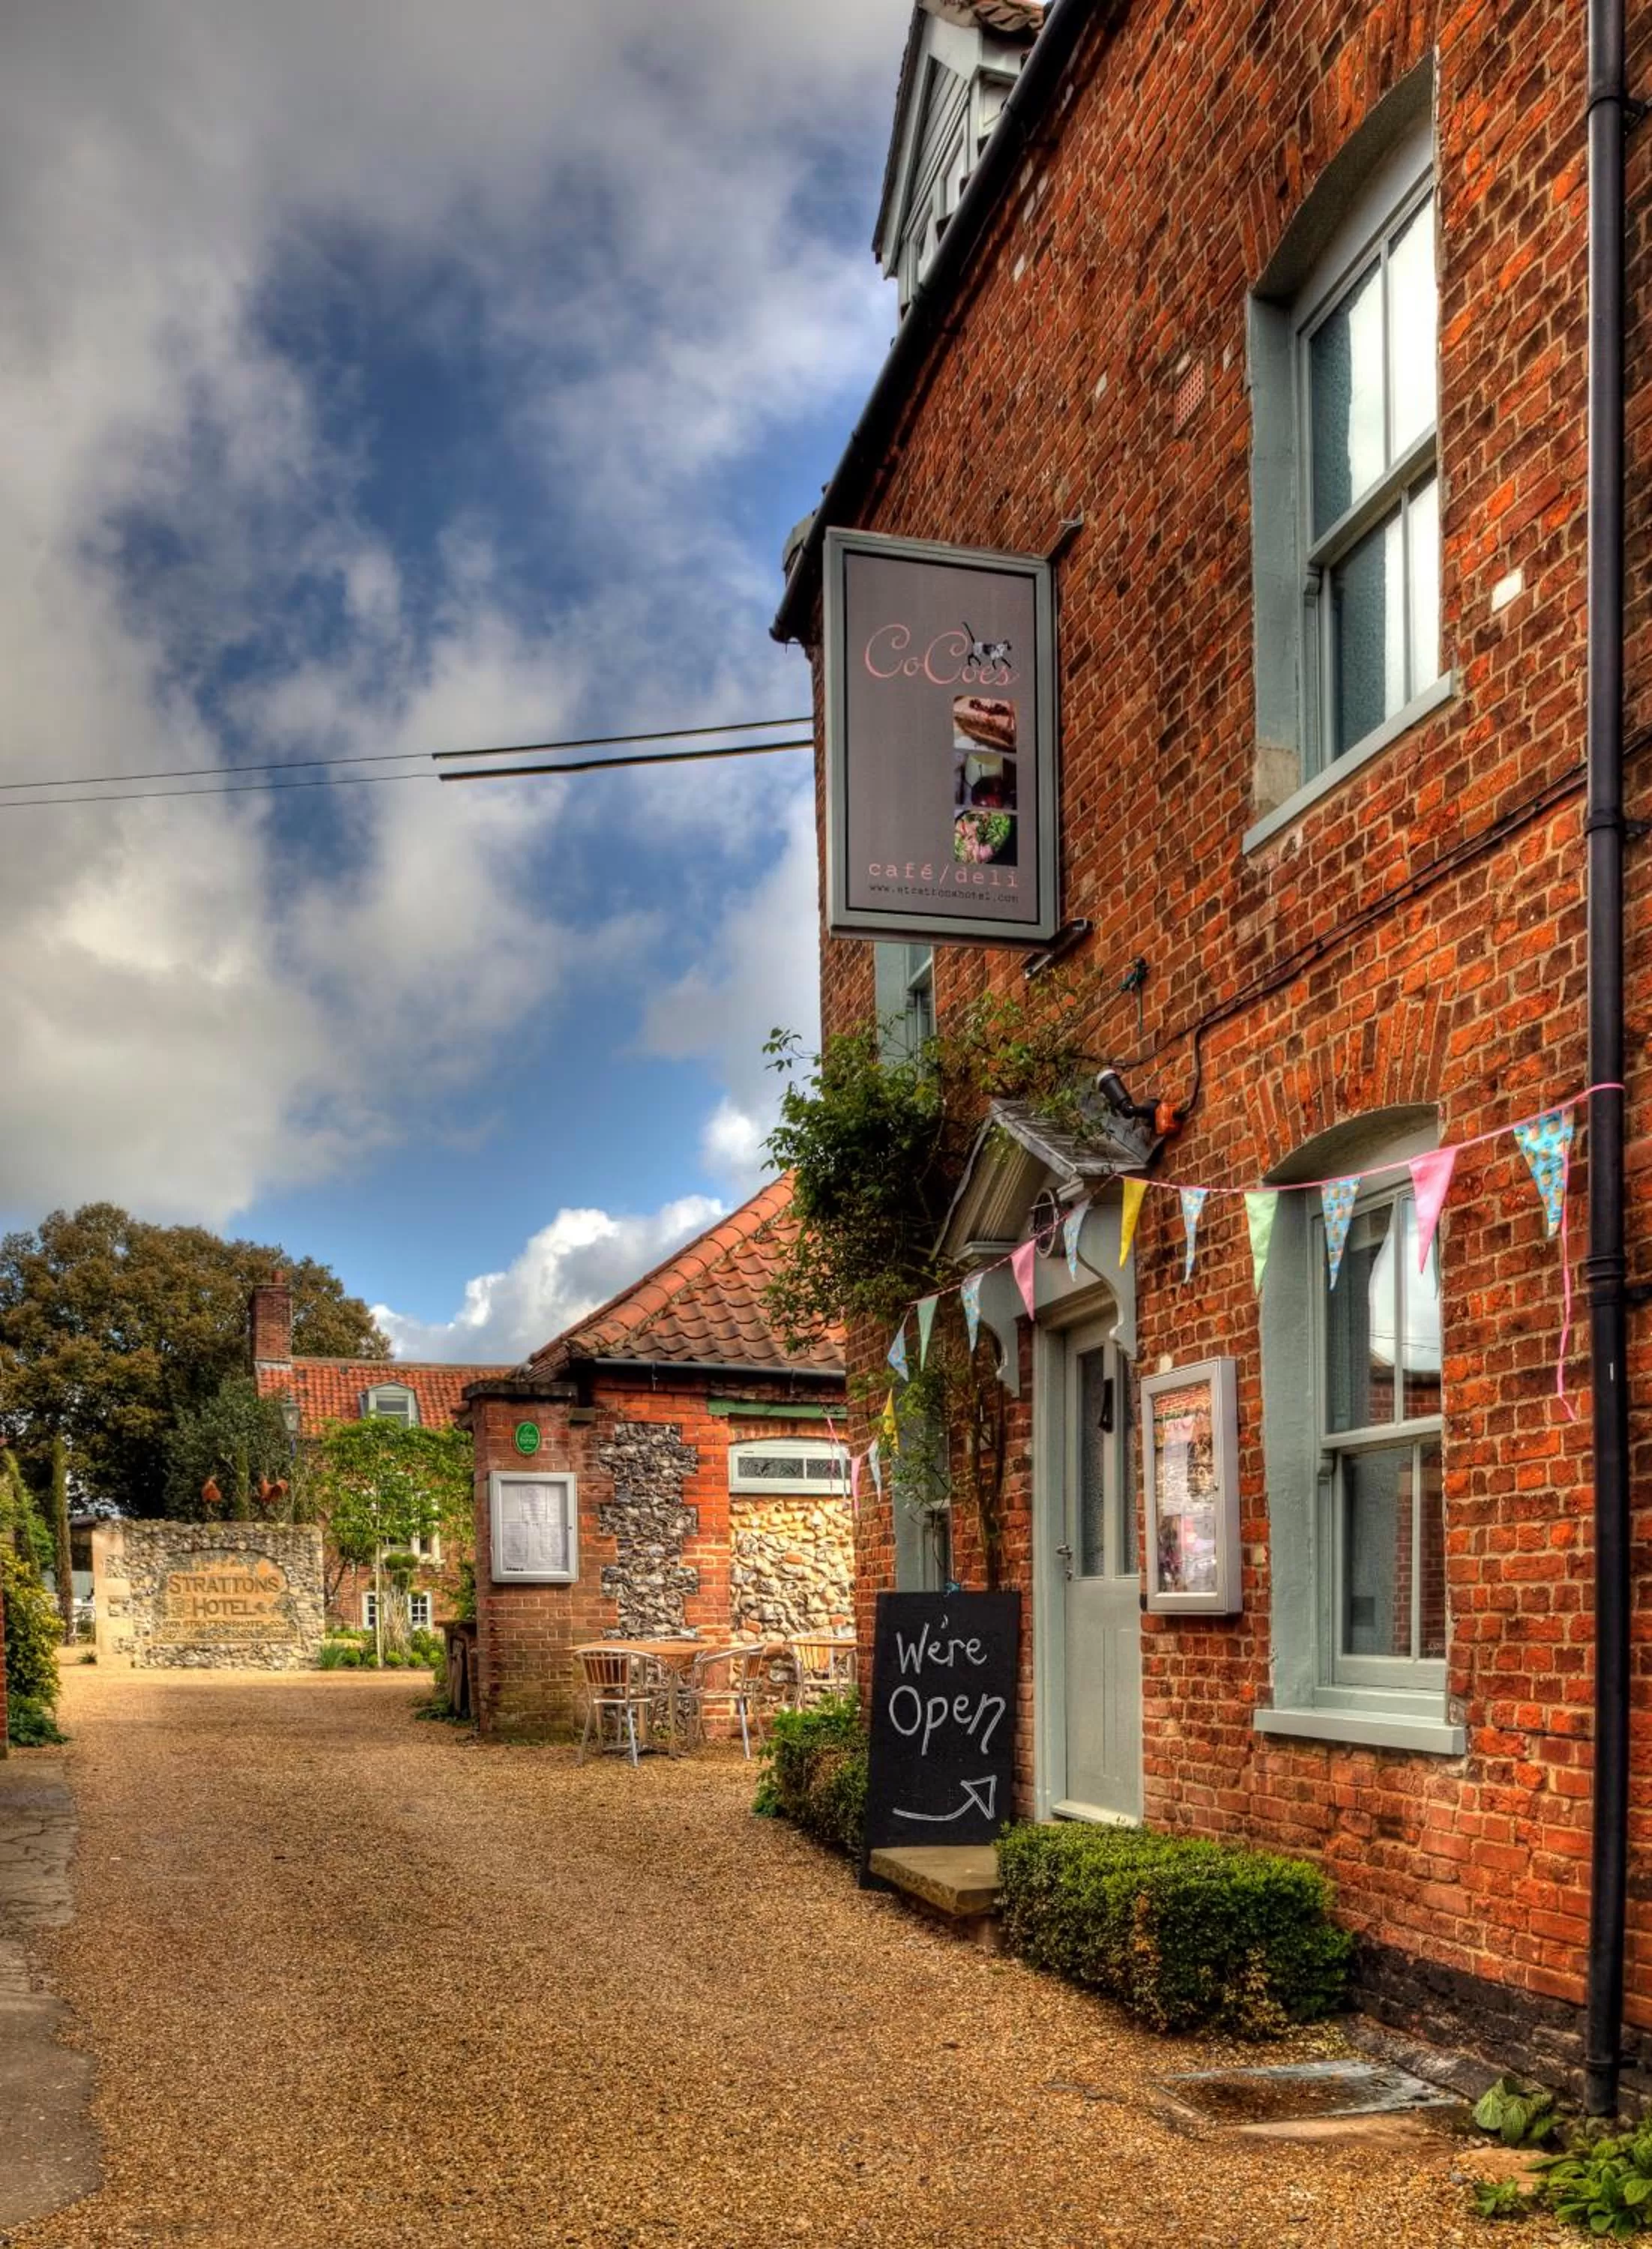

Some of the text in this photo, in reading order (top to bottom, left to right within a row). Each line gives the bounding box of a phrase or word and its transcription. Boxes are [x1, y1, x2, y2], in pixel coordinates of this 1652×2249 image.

[865, 624, 1019, 686] CoCoes
[868, 862, 1019, 888] café/deli
[169, 1574, 280, 1595] STRATTONS
[193, 1598, 257, 1618] HOTEL
[896, 1614, 988, 1675] We're
[888, 1685, 1007, 1756] Open
